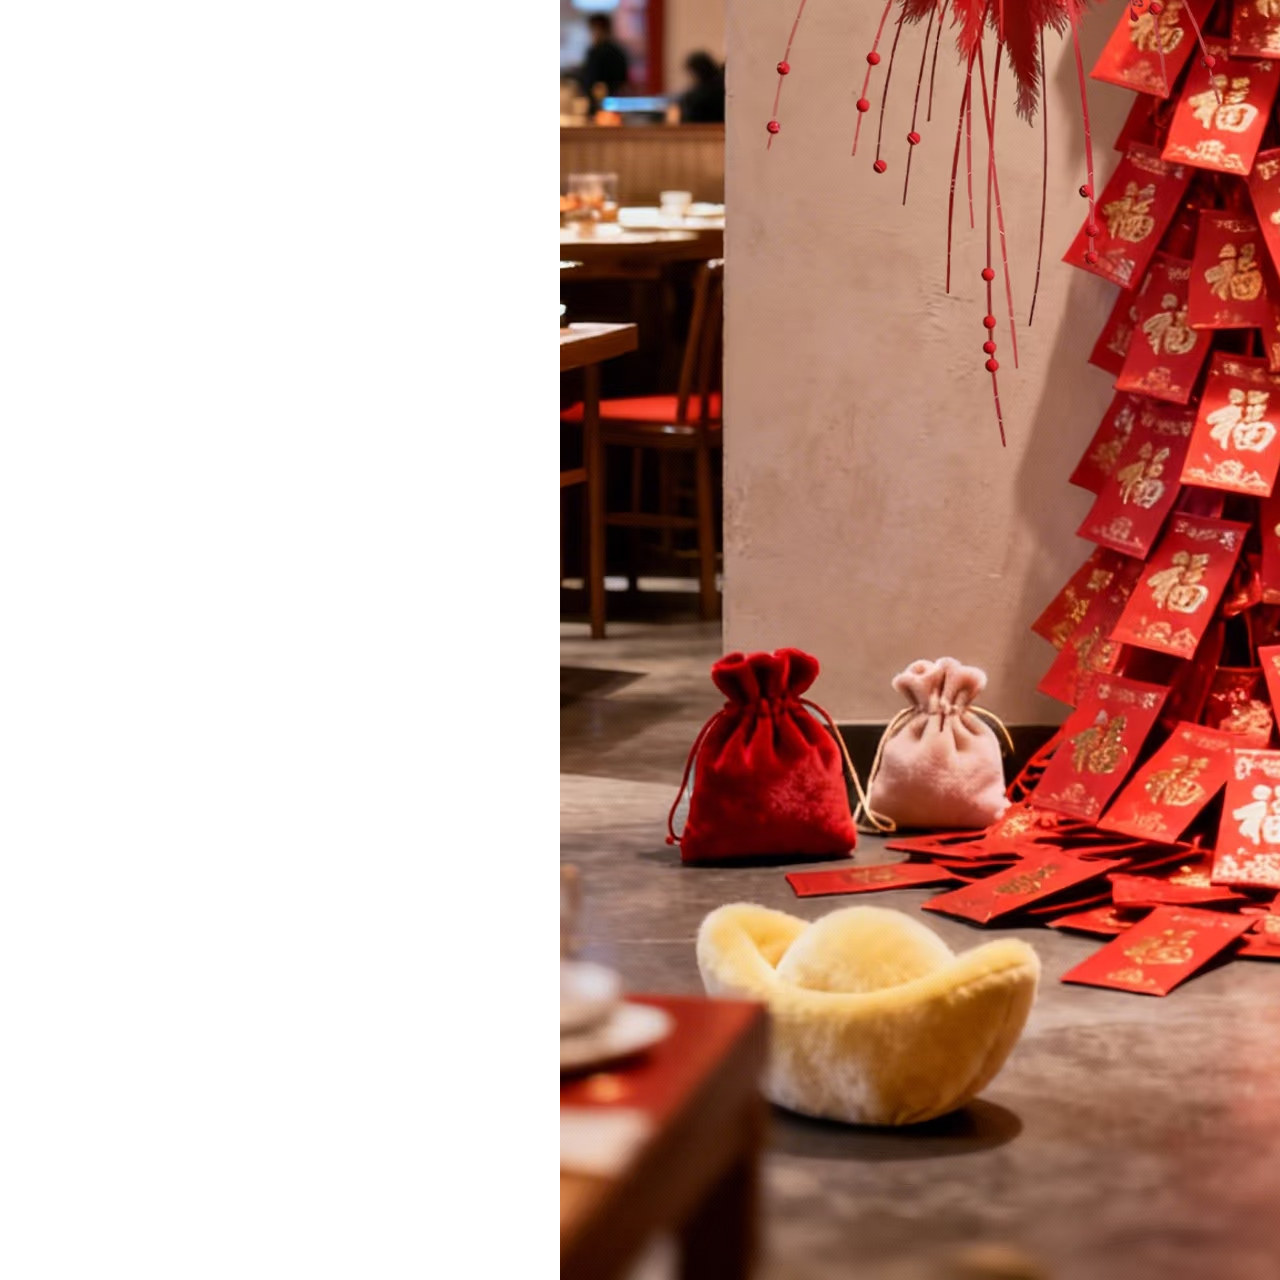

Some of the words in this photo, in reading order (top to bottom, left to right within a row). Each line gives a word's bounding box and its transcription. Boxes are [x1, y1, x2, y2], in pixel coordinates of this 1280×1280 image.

[1187, 74, 1258, 133] 福
[1102, 181, 1156, 243] 福
[1204, 243, 1263, 301] 福
[1205, 388, 1277, 452] 福
[1117, 441, 1165, 509] 福
[1147, 550, 1209, 614] 福
